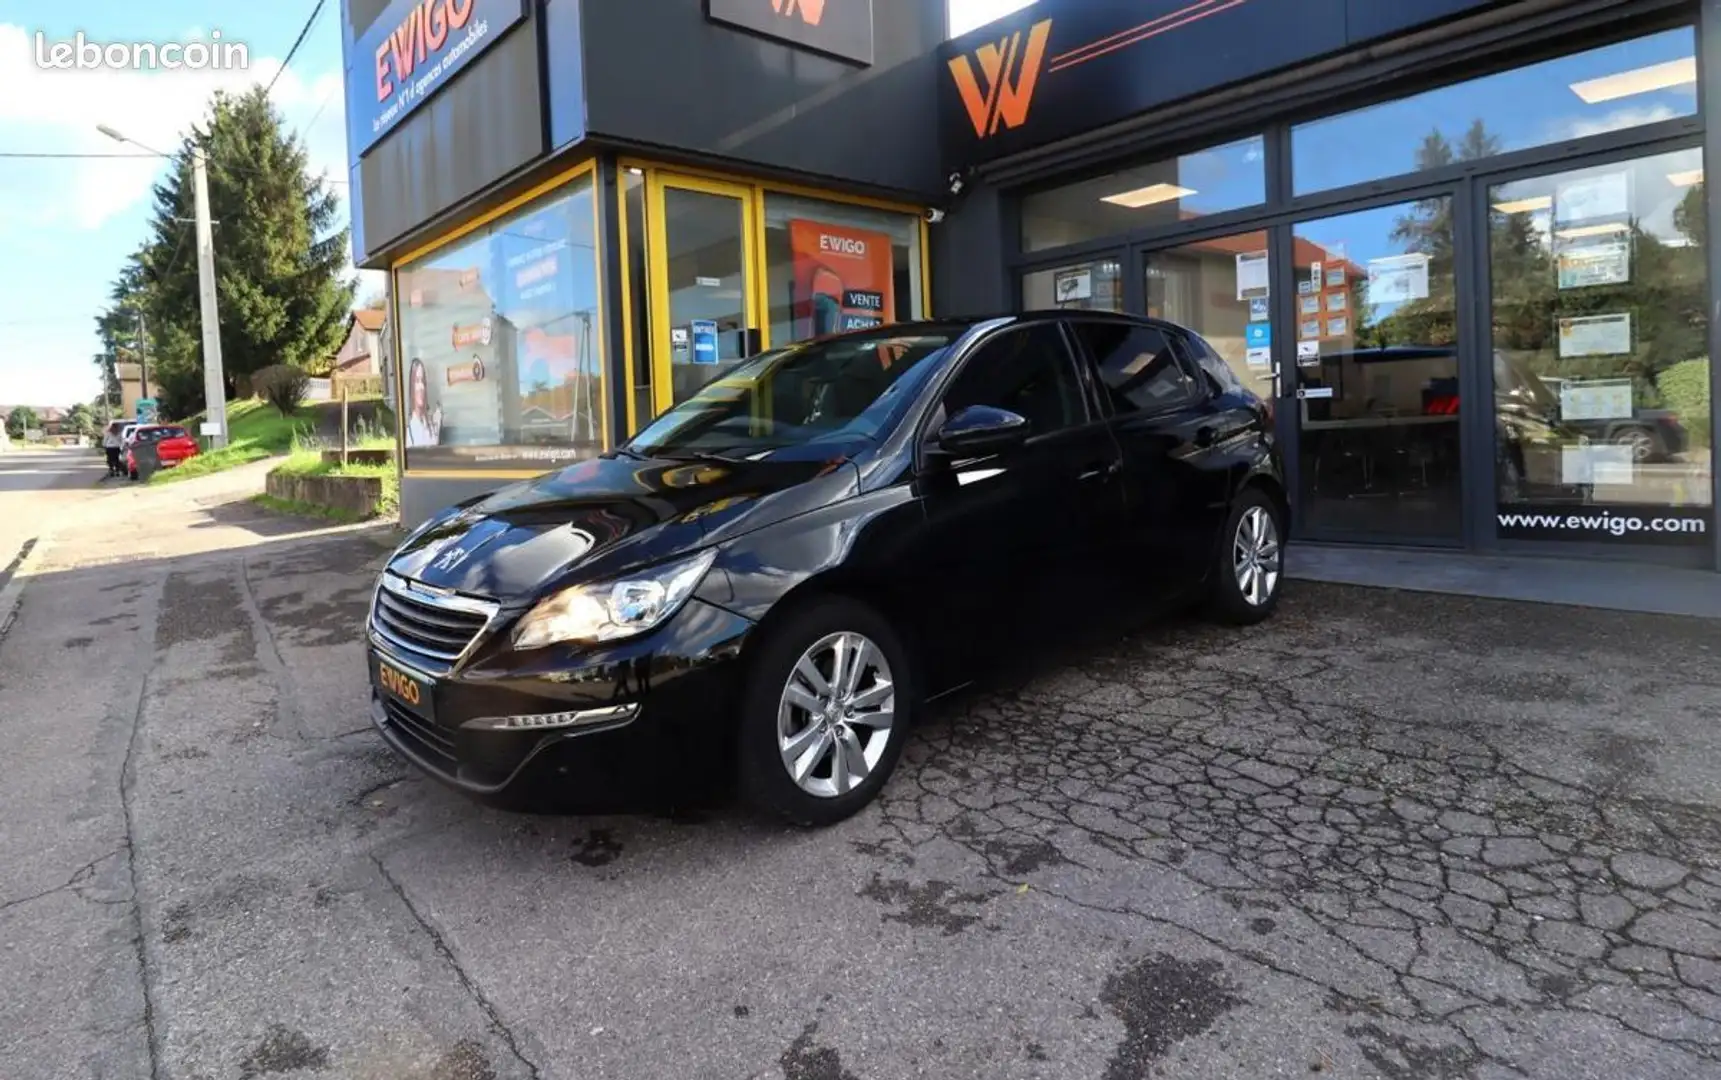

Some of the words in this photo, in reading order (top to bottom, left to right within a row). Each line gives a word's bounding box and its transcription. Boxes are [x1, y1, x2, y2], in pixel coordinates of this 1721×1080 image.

[820, 234, 865, 254] EWIGO
[849, 292, 881, 307] VENTE
[1497, 511, 1706, 536] www.ewigo.com
[380, 662, 419, 704] EWIGO
